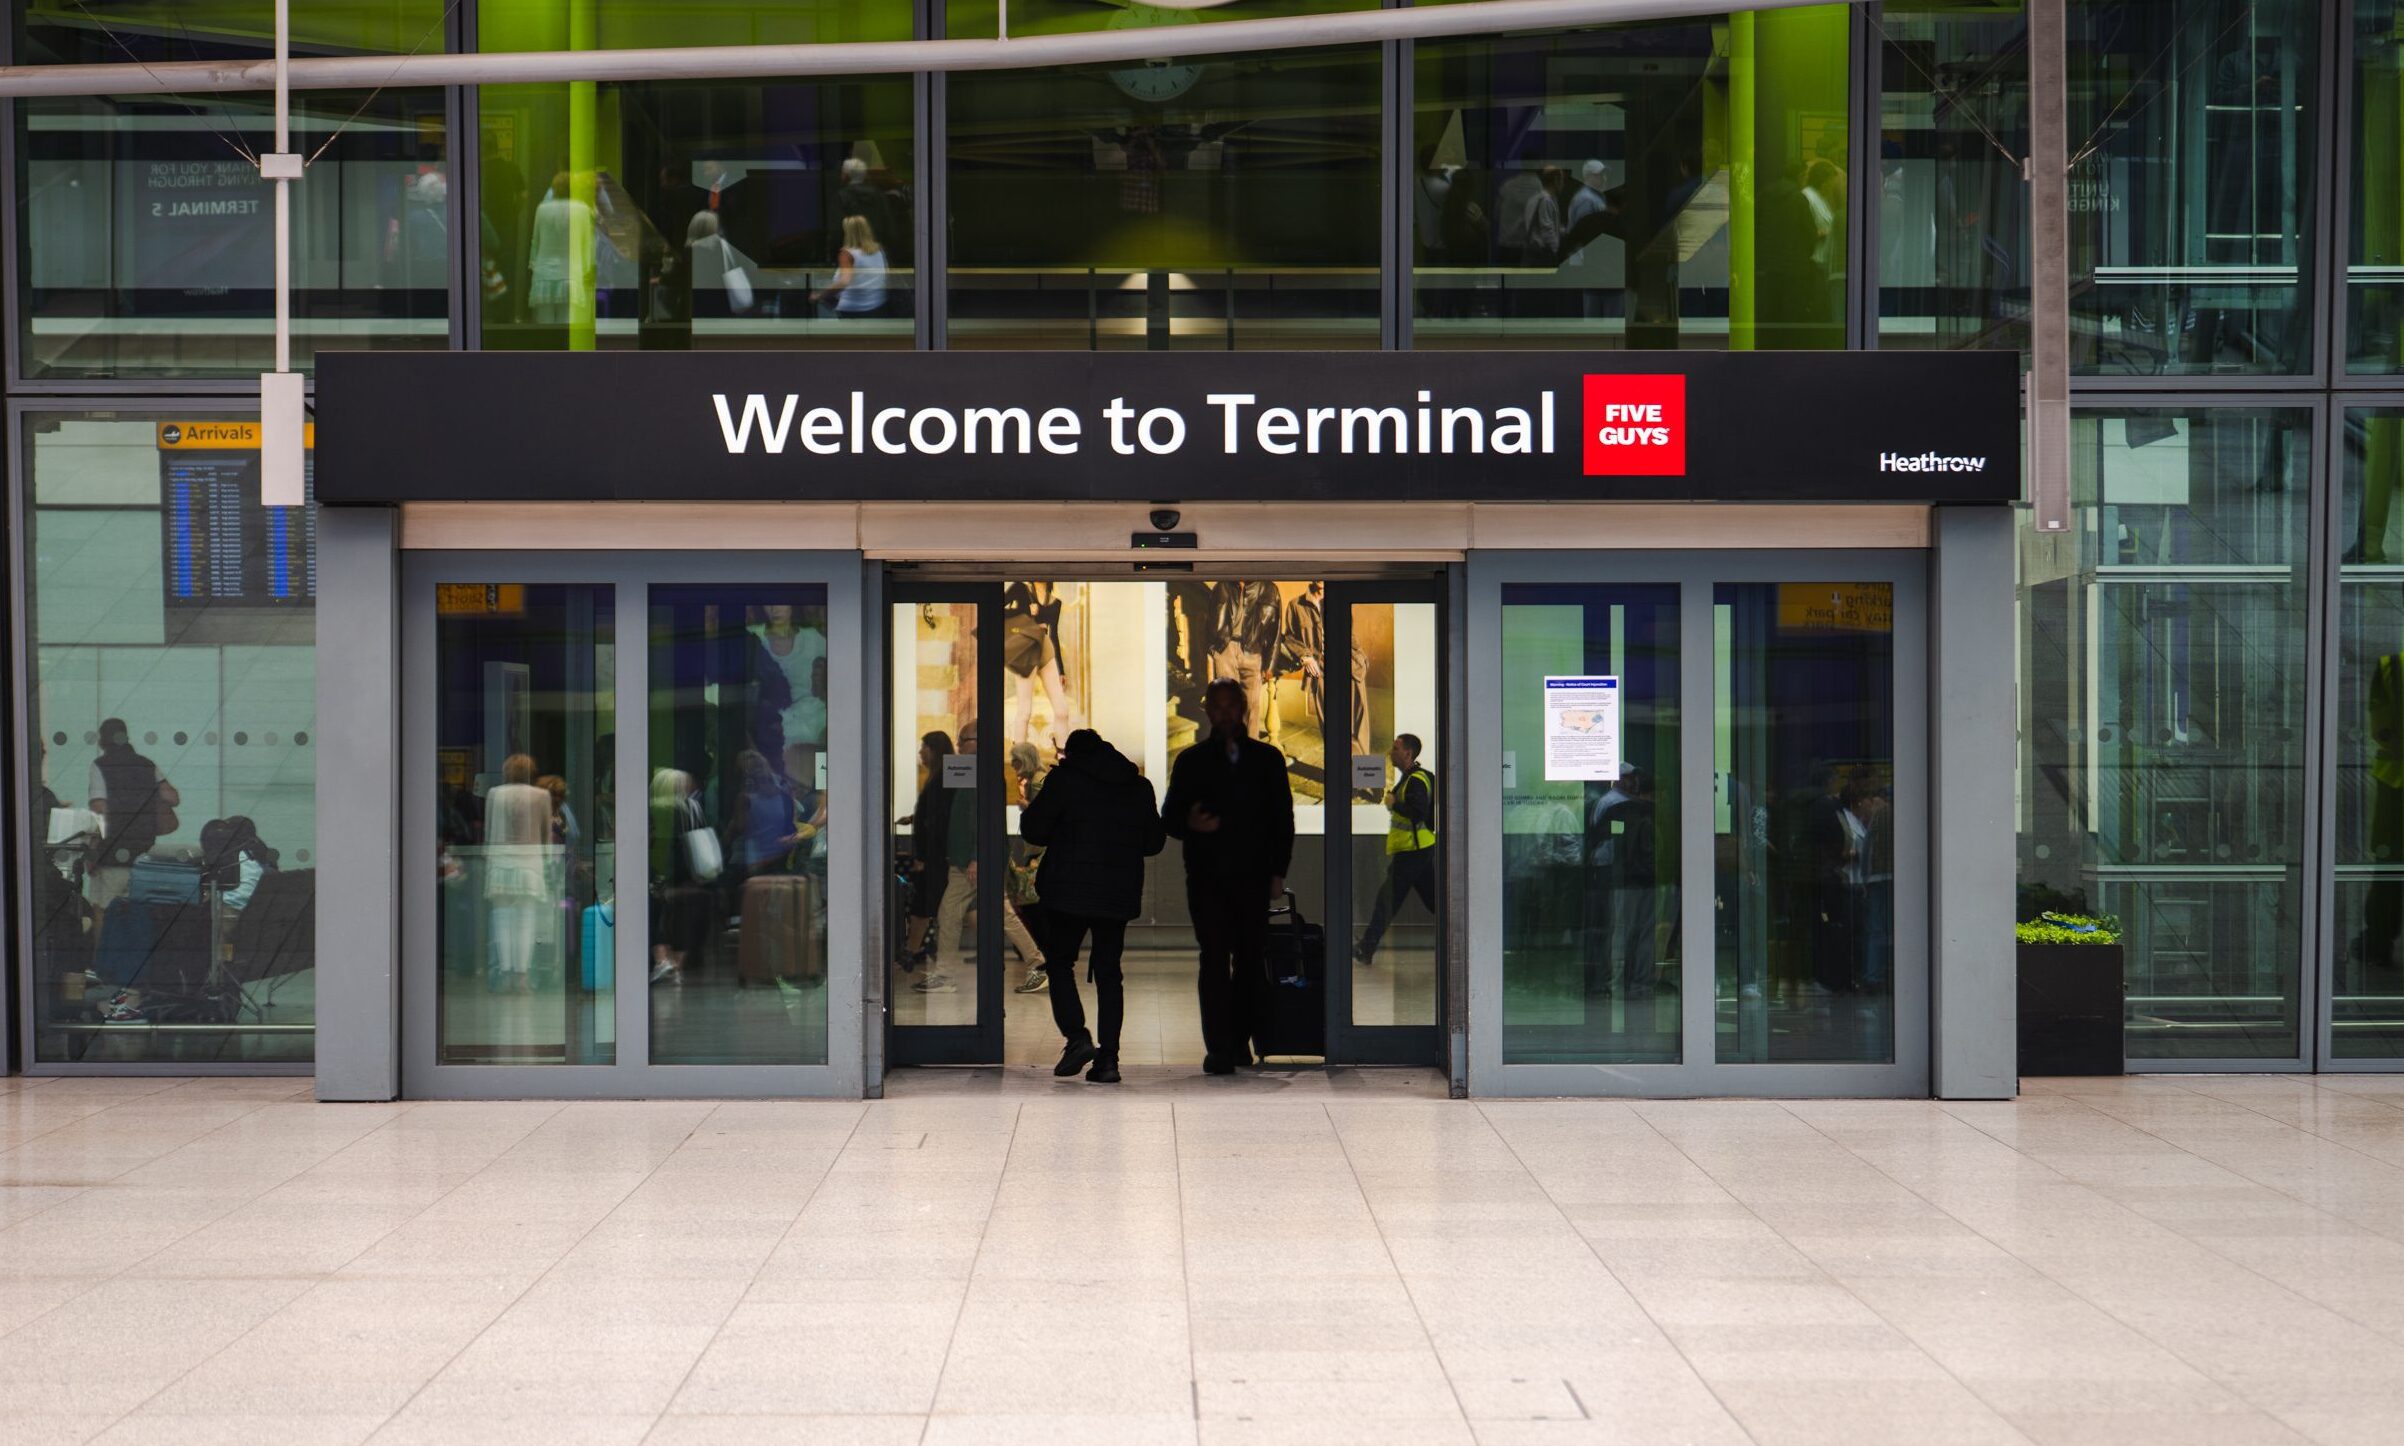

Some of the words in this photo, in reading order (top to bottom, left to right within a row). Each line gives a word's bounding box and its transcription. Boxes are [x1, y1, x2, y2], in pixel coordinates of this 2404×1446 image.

[713, 392, 1081, 454] Welcome
[1103, 397, 1185, 454] to
[1207, 391, 1553, 454] Terminal
[1606, 405, 1662, 422] FIVE
[186, 425, 253, 440] Arrivals
[1599, 427, 1669, 445] GUYS
[1881, 452, 1985, 472] Heathrow
